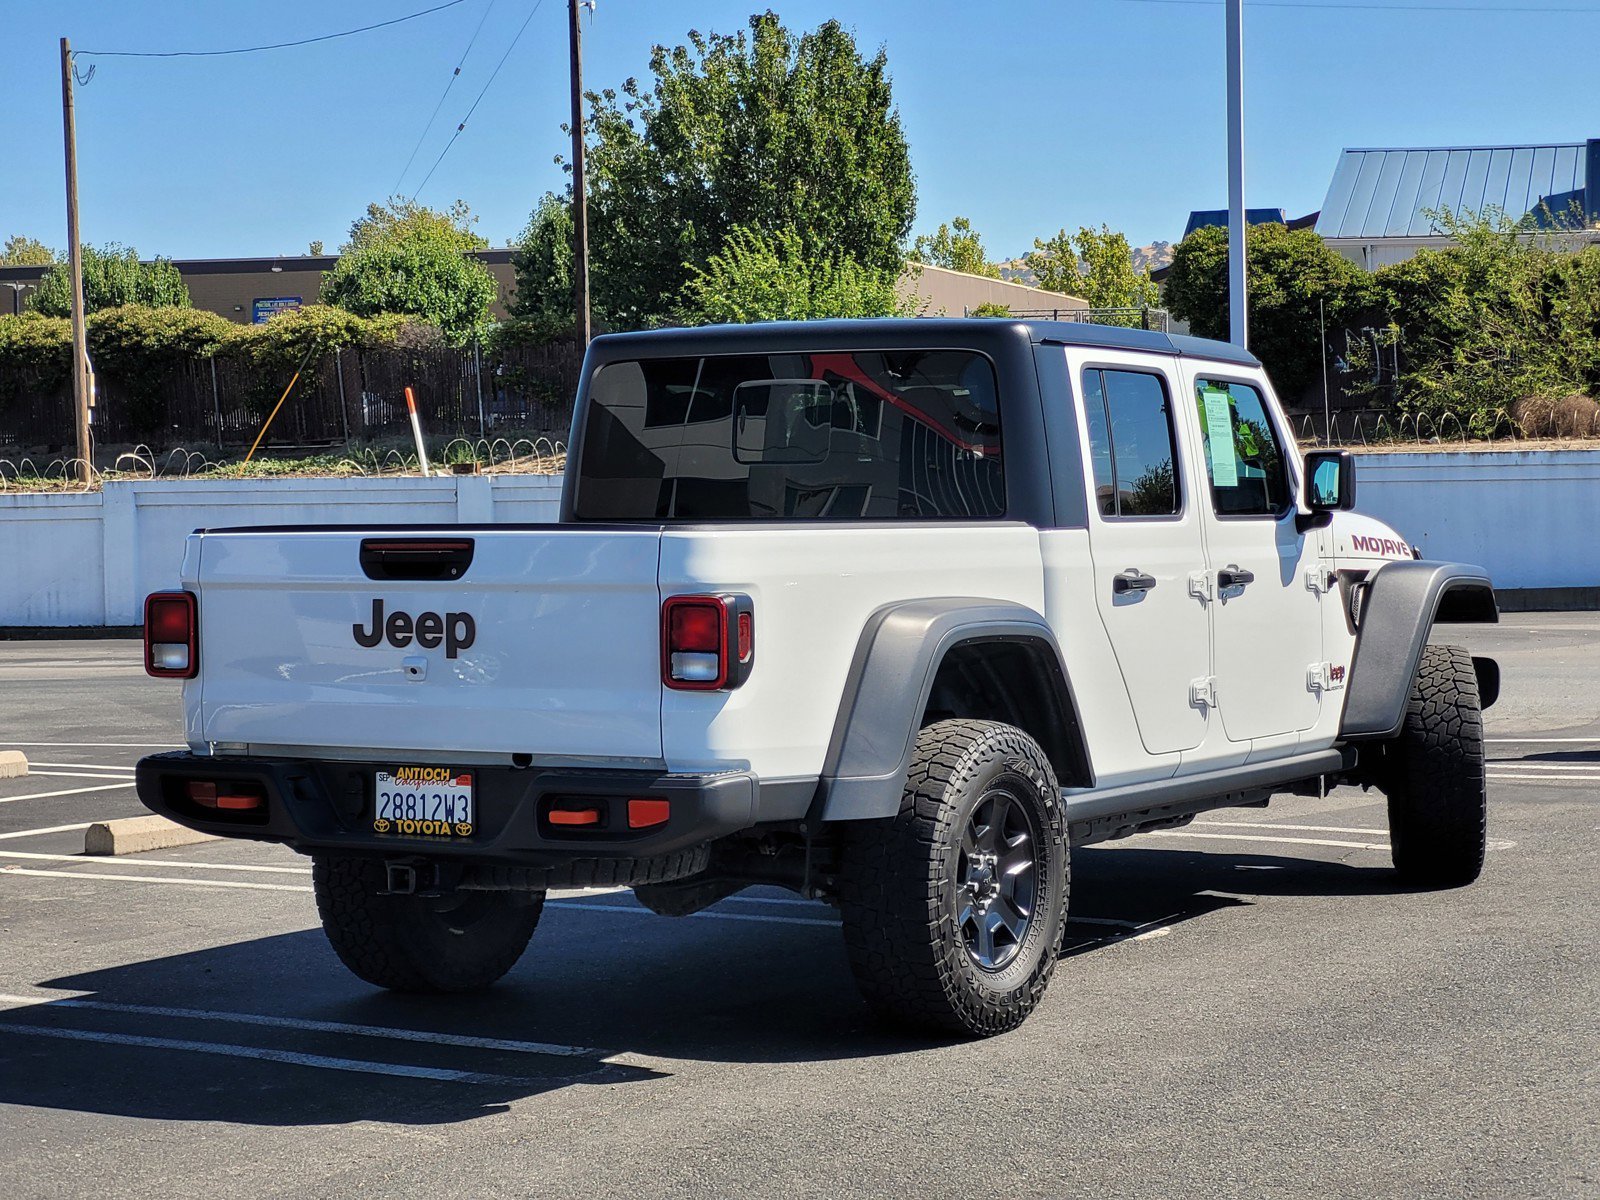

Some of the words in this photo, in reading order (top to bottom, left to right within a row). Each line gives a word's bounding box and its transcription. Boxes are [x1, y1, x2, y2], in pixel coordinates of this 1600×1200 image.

[1351, 534, 1410, 557] MOJAVE
[352, 599, 476, 659] Jeep
[396, 767, 450, 781] ANTIOCH
[380, 792, 468, 823] 28812W3
[1003, 757, 1061, 846] FALKEN
[396, 820, 451, 835] TOYOTA
